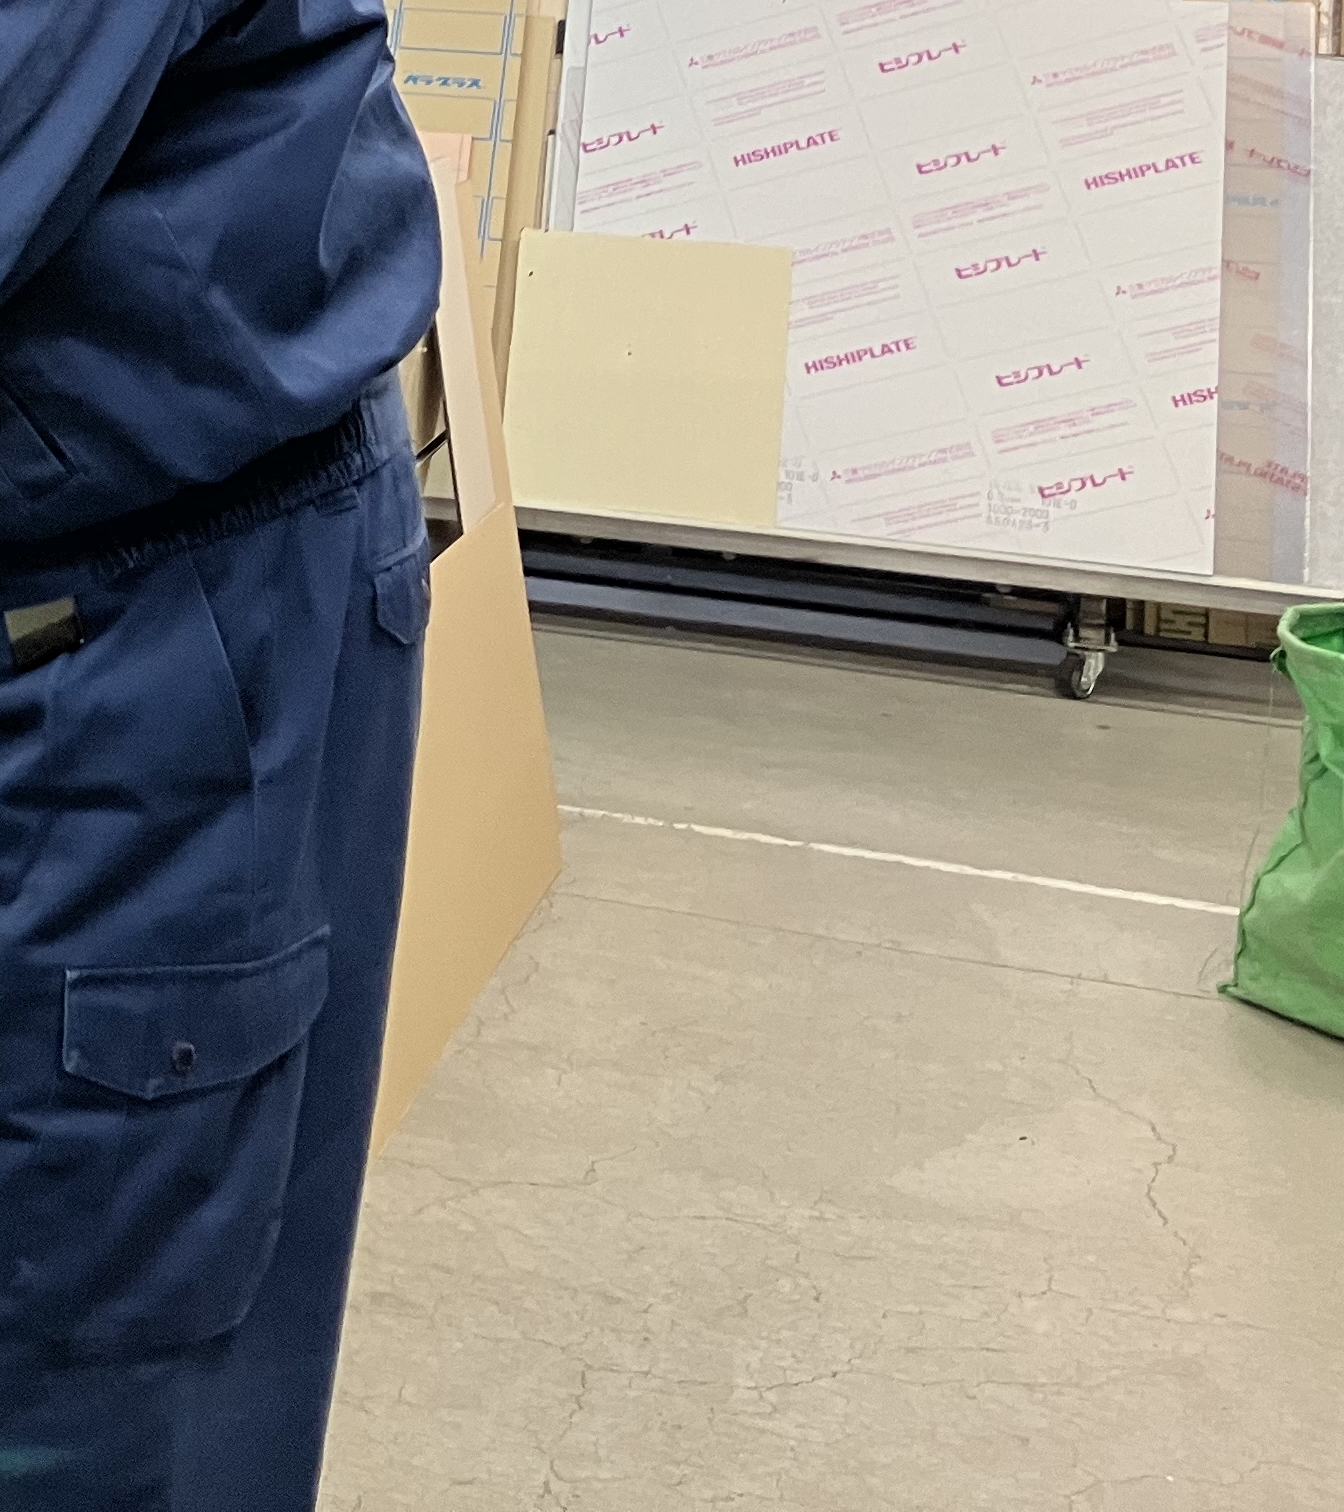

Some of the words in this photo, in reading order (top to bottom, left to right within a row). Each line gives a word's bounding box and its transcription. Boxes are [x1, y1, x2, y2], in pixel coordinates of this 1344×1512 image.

[733, 128, 841, 168] HISHIPLATE
[1084, 149, 1205, 191] HISHIPLATE
[804, 336, 918, 376] HISHIPLATE
